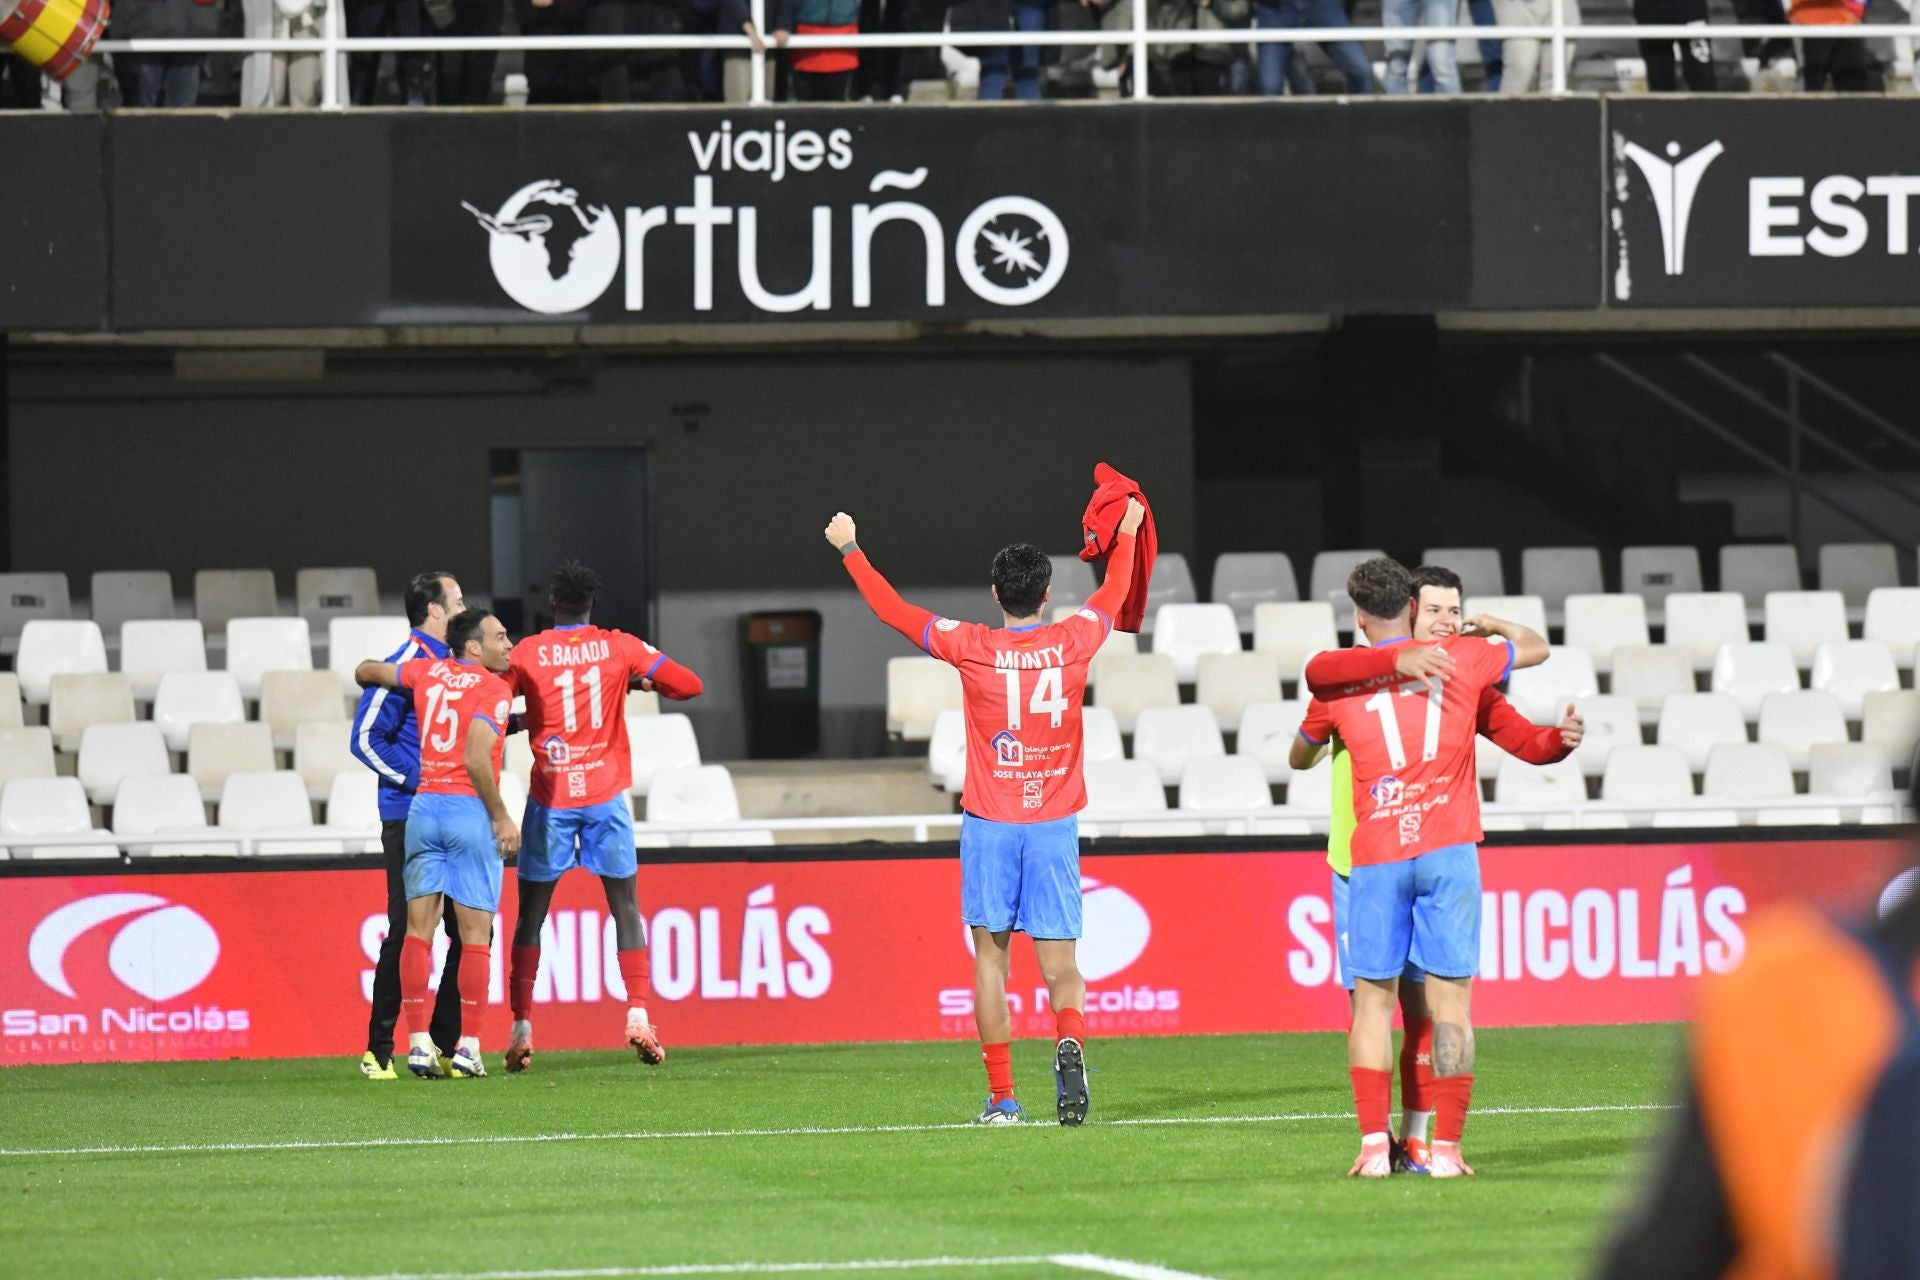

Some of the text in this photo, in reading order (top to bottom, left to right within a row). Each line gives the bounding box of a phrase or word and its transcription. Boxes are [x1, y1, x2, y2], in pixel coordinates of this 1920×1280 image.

[688, 120, 853, 182] viajes
[1749, 174, 1920, 258] EST
[995, 644, 1065, 669] MONTY
[420, 683, 463, 753] 15
[553, 665, 603, 733] 11
[995, 667, 1069, 730] 14
[1365, 675, 1444, 772] 17
[992, 770, 1014, 779] JOSE
[1015, 771, 1043, 779] BLAYA
[1023, 800, 1043, 809] ROS
[2, 1004, 250, 1036] San Nicolás
[938, 985, 1179, 1016] Sn colás
